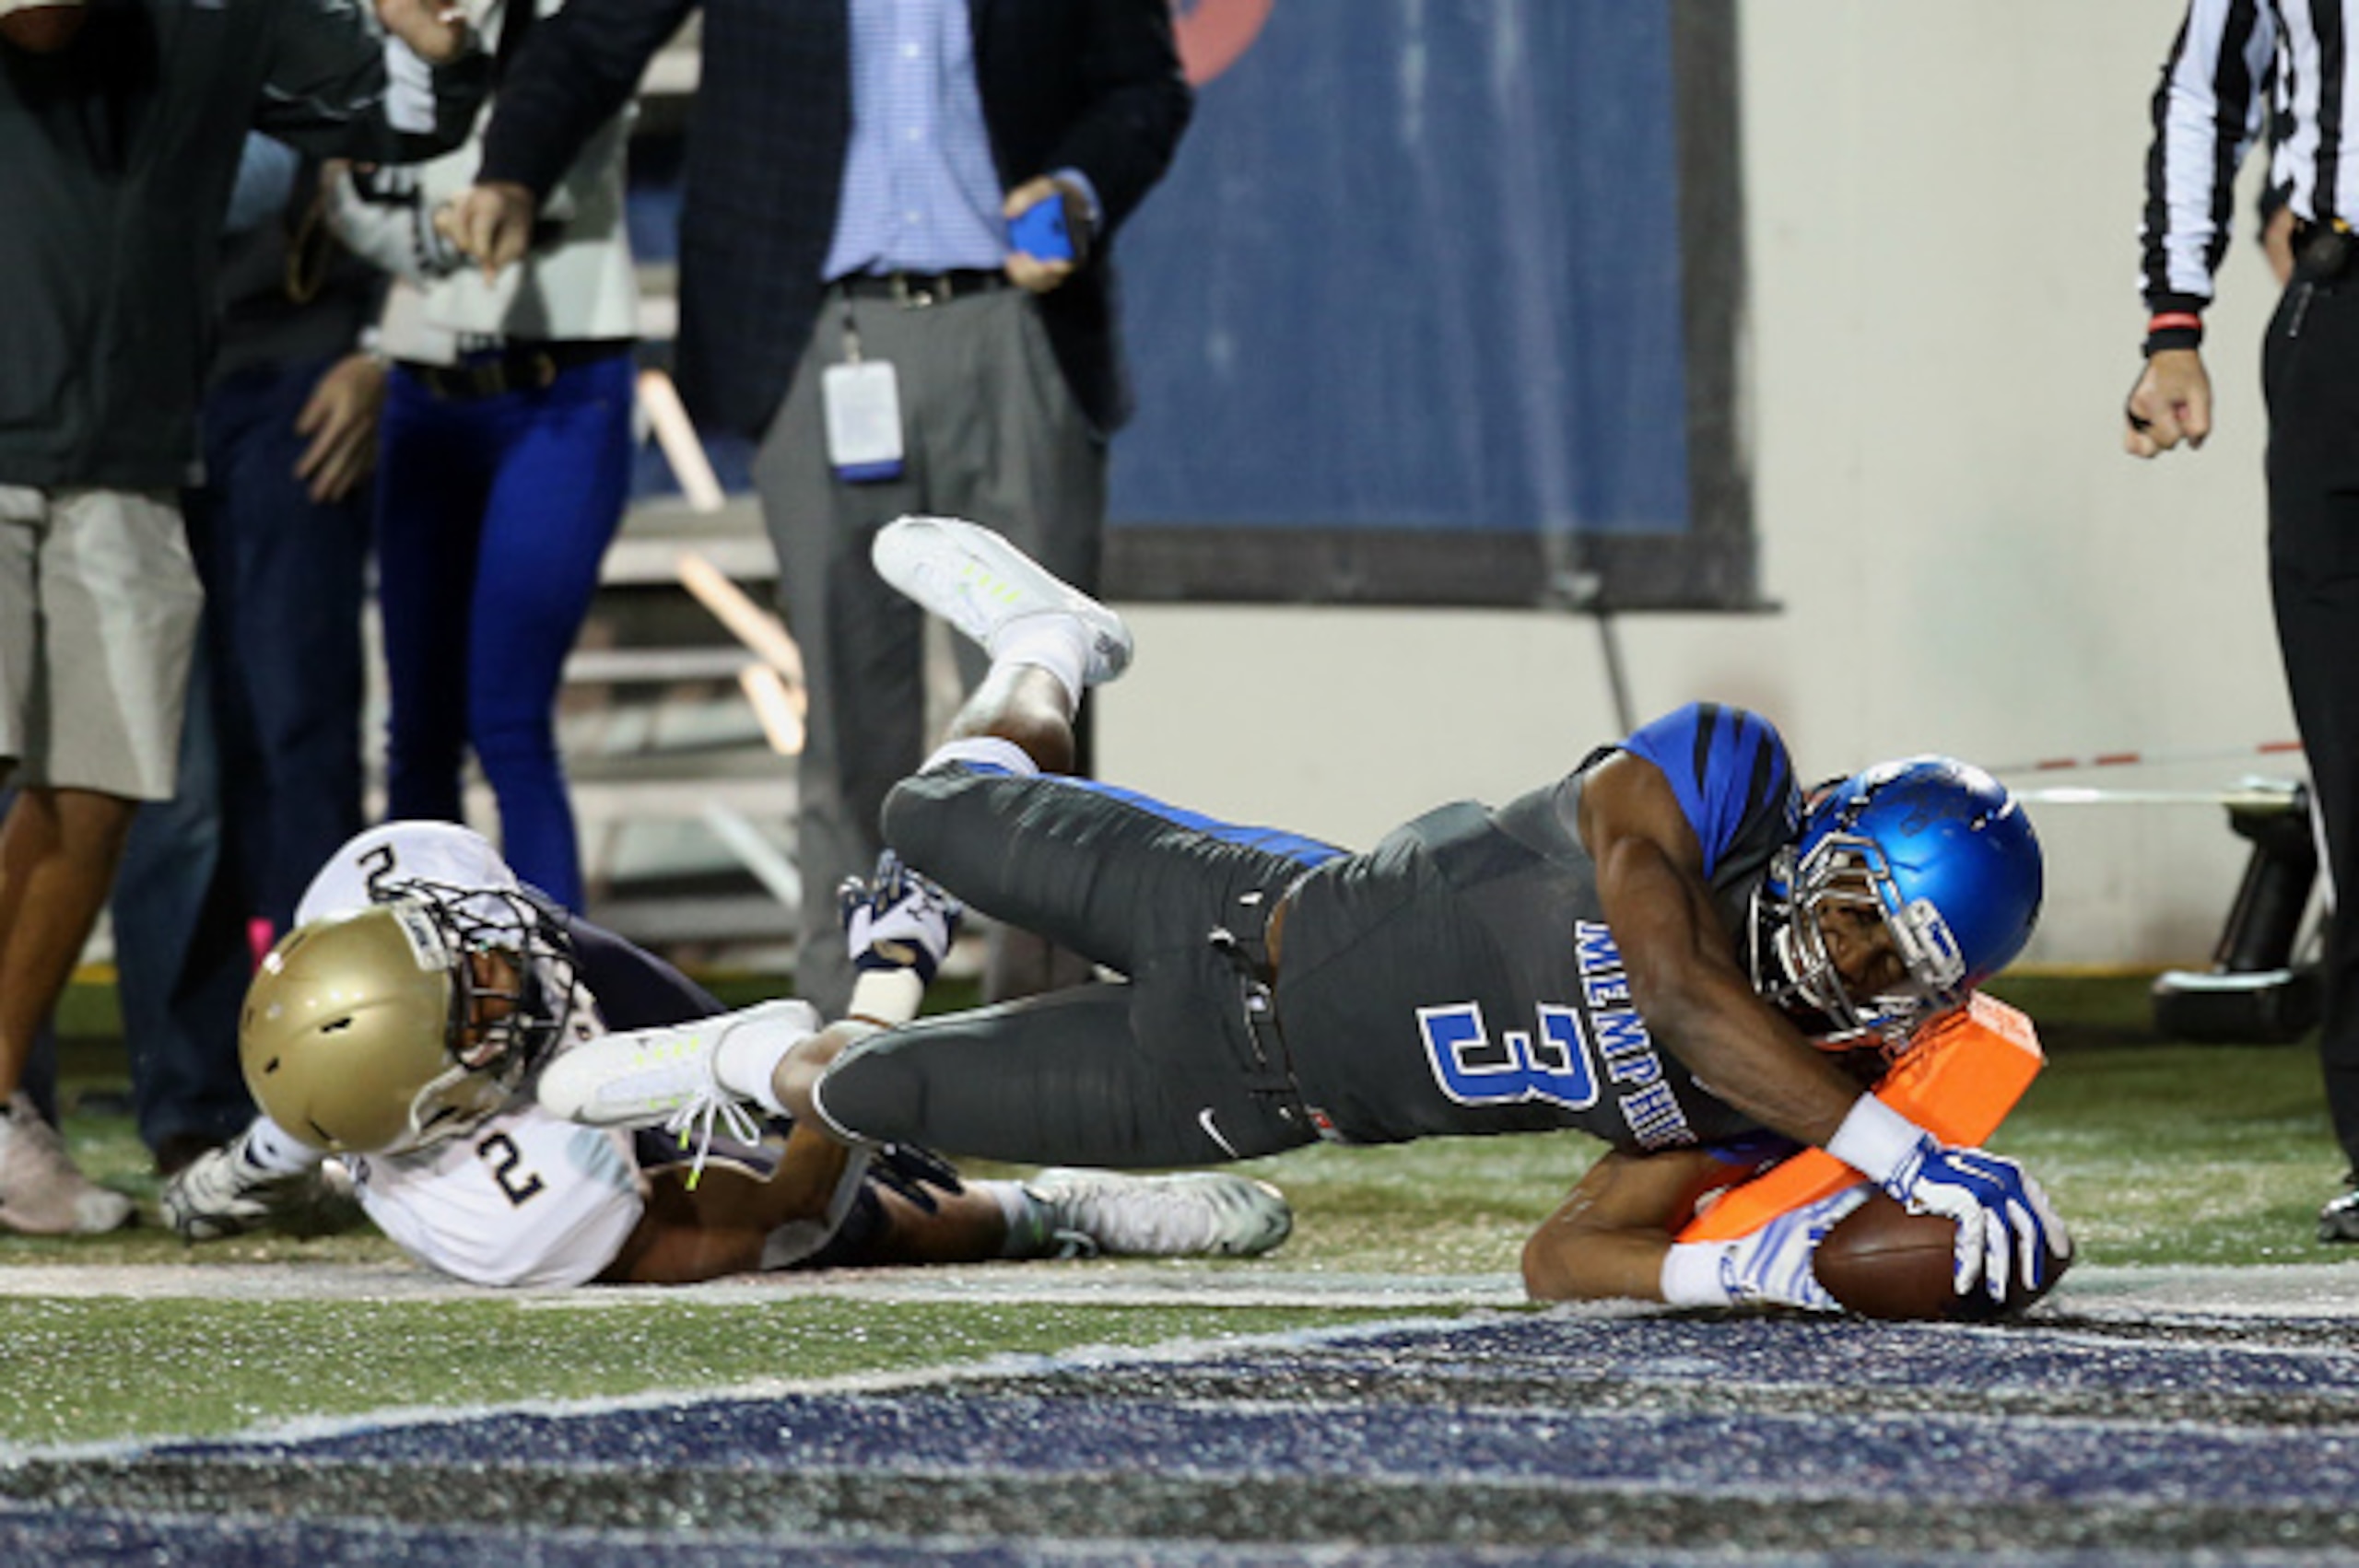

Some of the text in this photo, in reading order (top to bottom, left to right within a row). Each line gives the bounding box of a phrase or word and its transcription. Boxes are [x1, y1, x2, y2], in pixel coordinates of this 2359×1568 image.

[357, 843, 404, 904] 2
[1415, 1000, 1600, 1110] 3
[476, 1131, 546, 1206] 2
